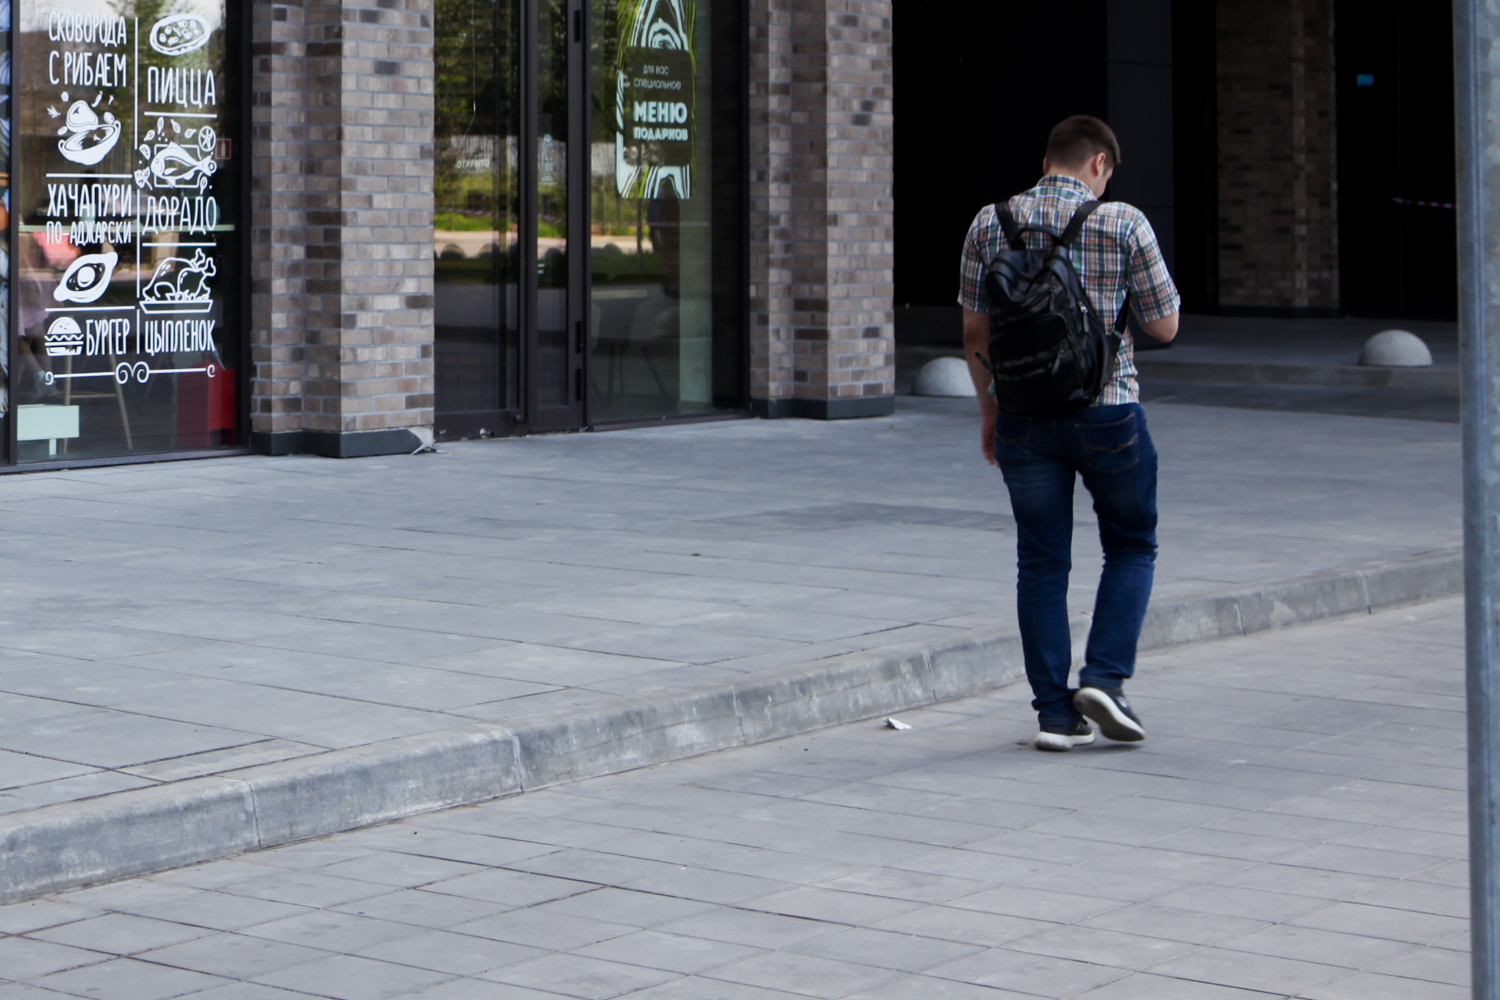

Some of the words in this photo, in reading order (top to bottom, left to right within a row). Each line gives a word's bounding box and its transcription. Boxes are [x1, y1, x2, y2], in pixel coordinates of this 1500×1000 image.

[49, 12, 127, 47] СКОВОРОДА
[49, 51, 60, 85] С
[64, 51, 127, 87] РИБАЕМ
[148, 66, 216, 109] ПИЦЦА
[633, 100, 688, 124] МЕНЮ
[632, 126, 689, 142] ПОДАРКОВ
[47, 183, 132, 217] ХАЧАПУРИ
[142, 196, 217, 235] ДОРАДО
[46, 221, 132, 246] ПО-АДЖАРСКИ
[86, 318, 131, 356] БУРГЕР
[144, 319, 216, 357] ЦЫПЛЕНОК
